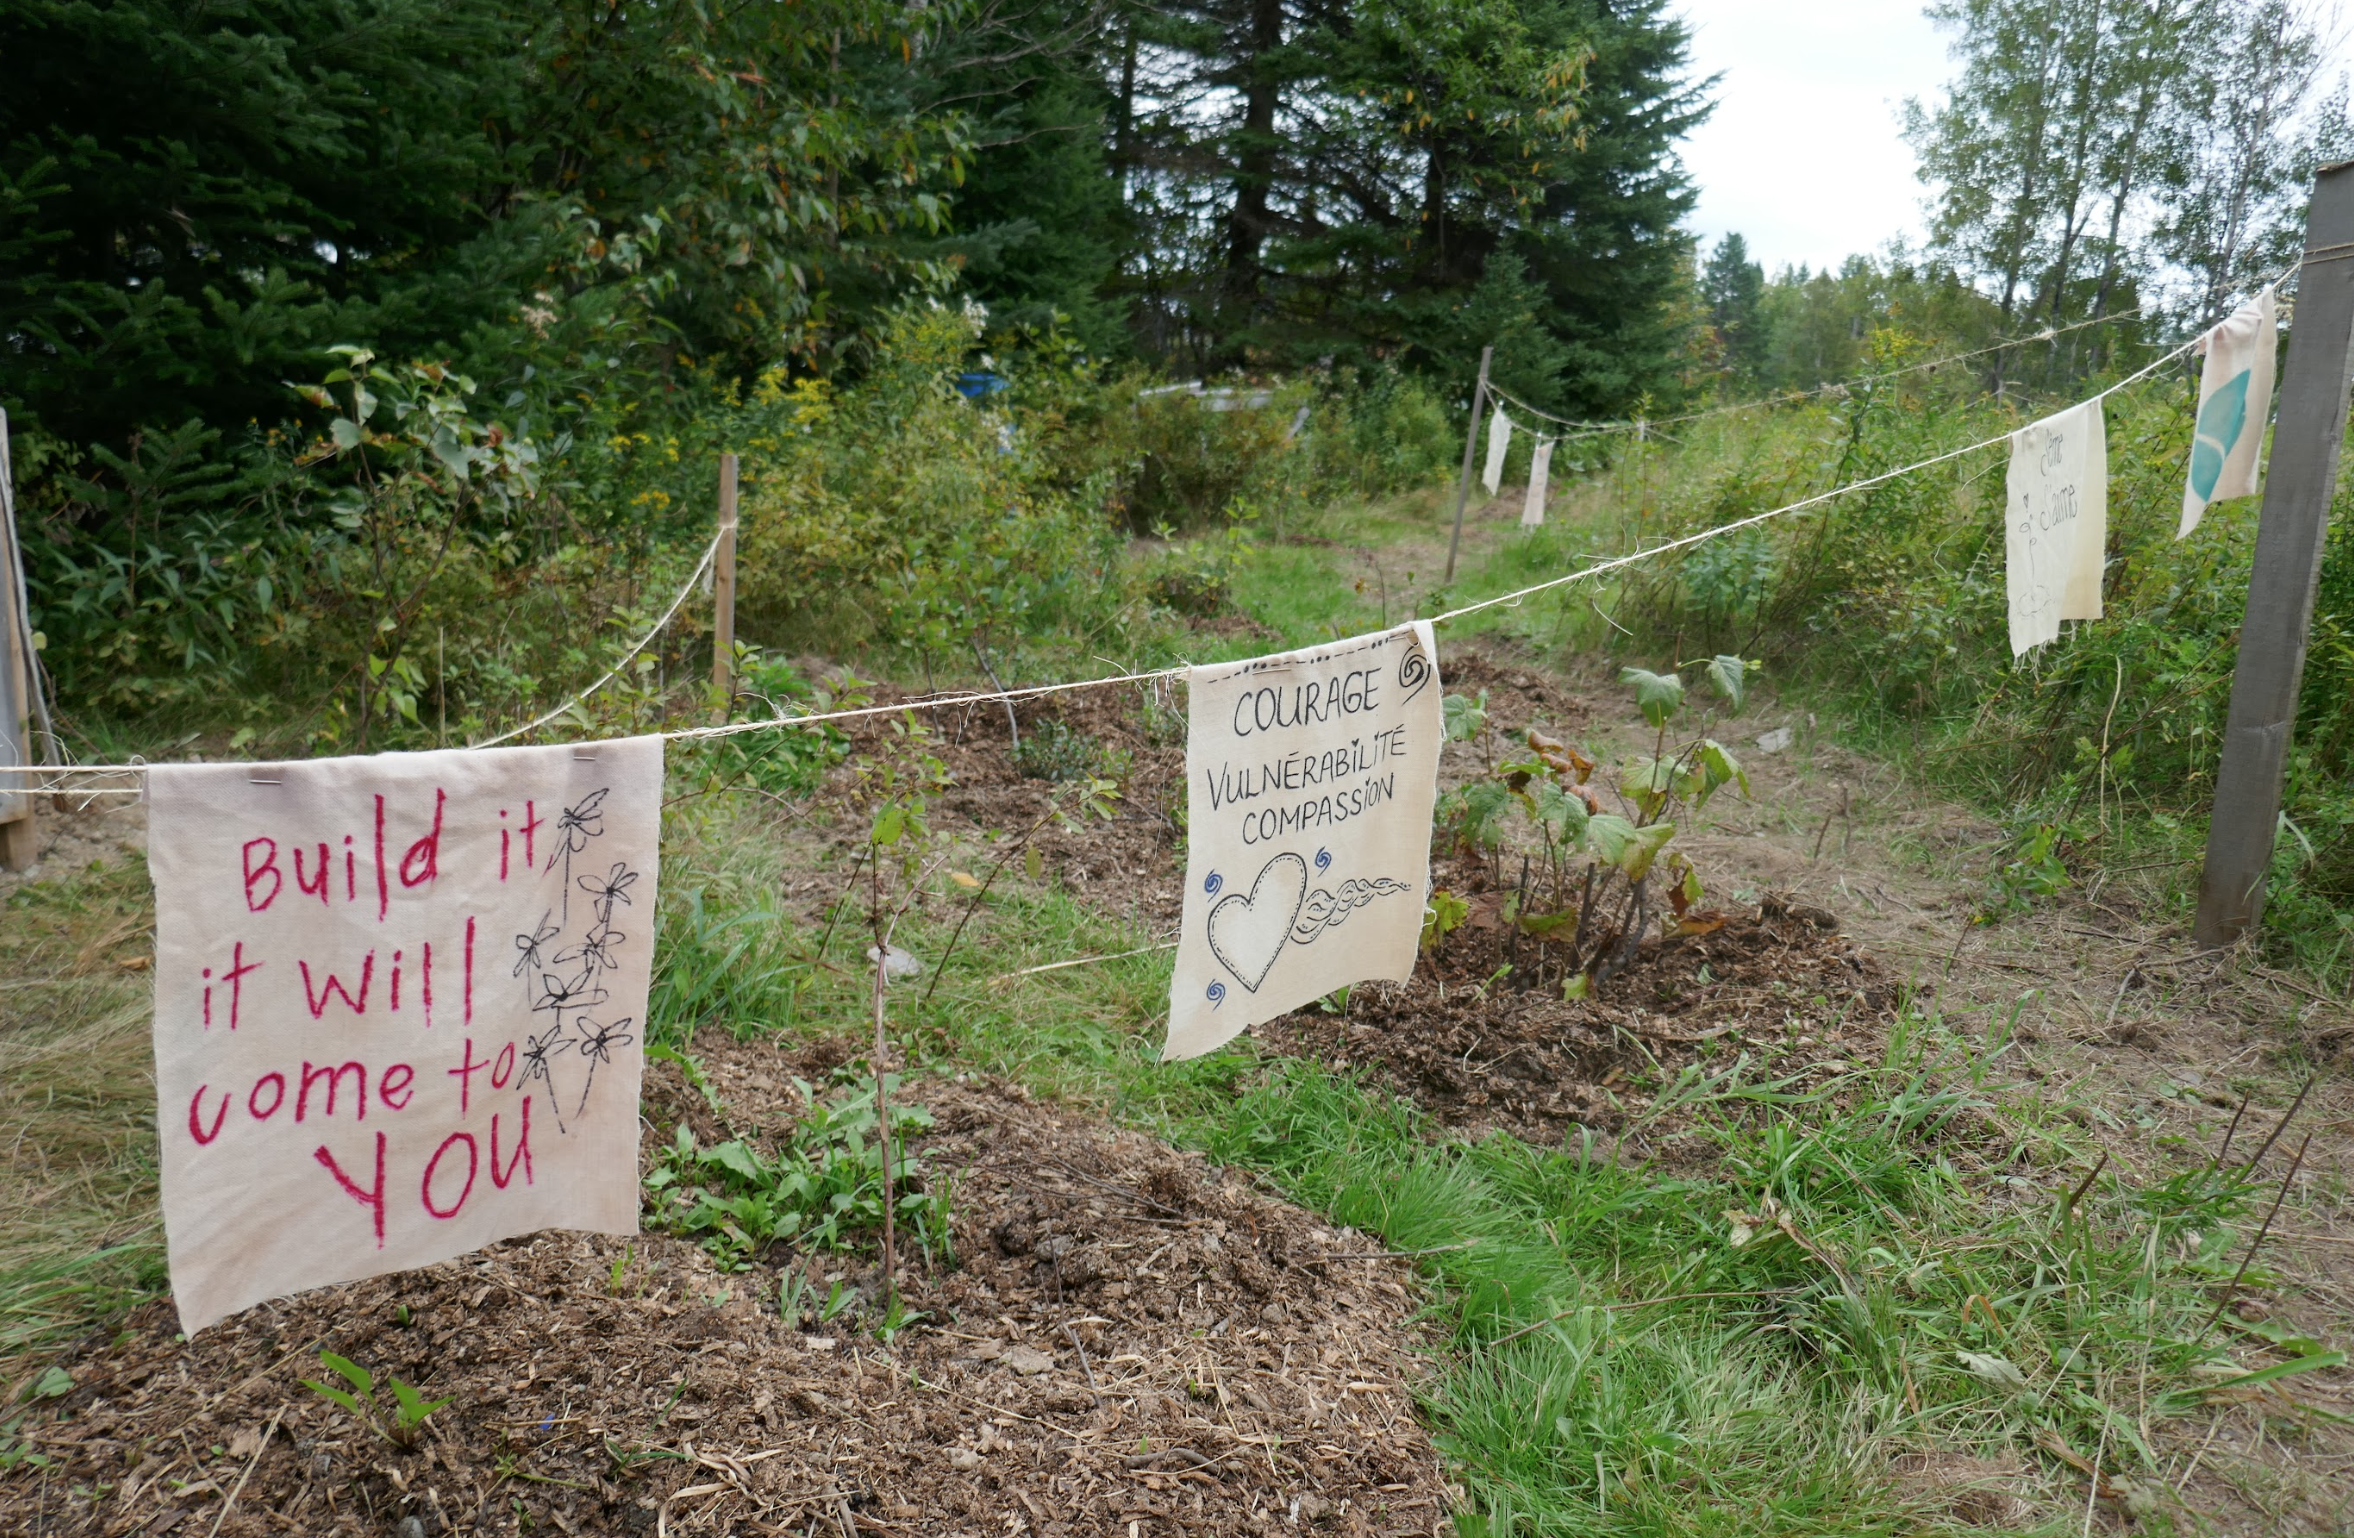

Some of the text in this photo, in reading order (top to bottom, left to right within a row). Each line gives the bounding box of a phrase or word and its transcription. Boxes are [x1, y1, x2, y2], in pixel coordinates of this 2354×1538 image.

[1233, 667, 1383, 738] COURAGE
[241, 787, 547, 922] Build it
[1242, 772, 1394, 845] COMPASSION
[202, 915, 476, 1031] it will
[188, 1038, 515, 1146] come to
